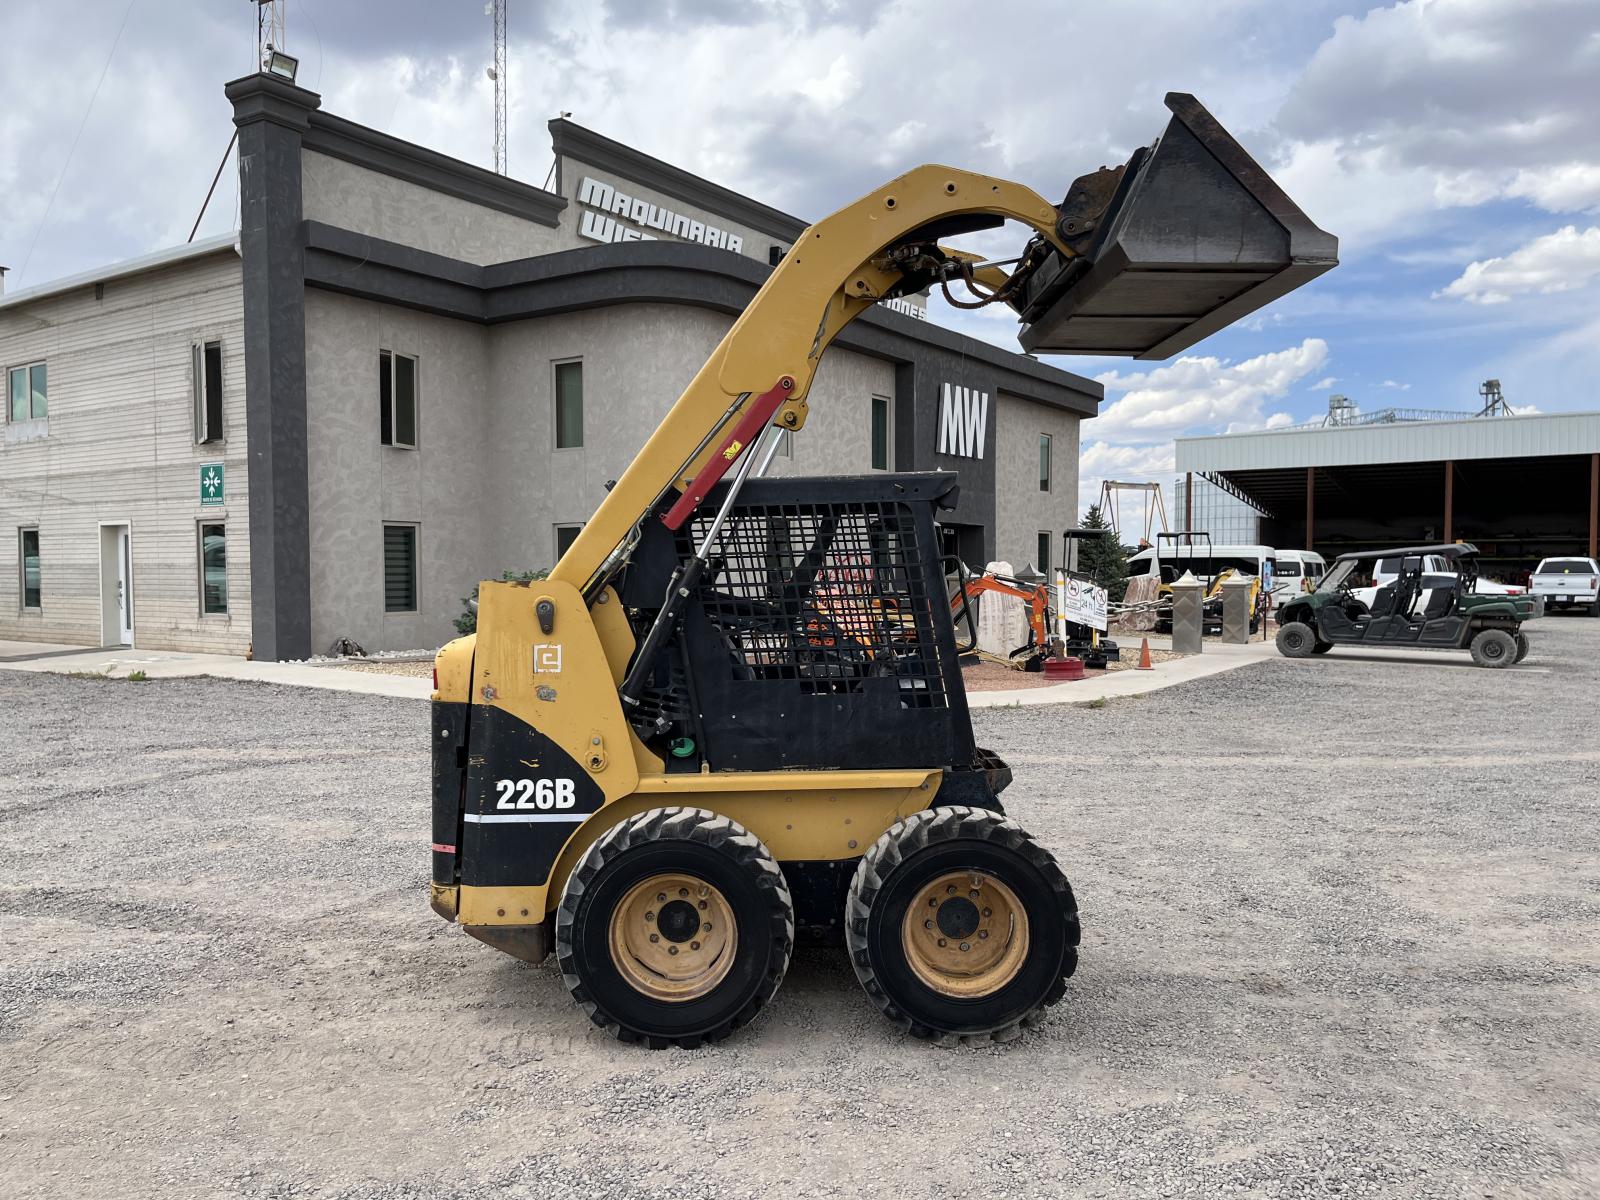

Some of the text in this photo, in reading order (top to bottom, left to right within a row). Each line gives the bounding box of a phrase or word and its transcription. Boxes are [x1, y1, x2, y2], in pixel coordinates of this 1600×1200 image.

[578, 176, 744, 254] MAQUINARIA
[938, 382, 989, 460] MW
[496, 778, 576, 810] 226B
